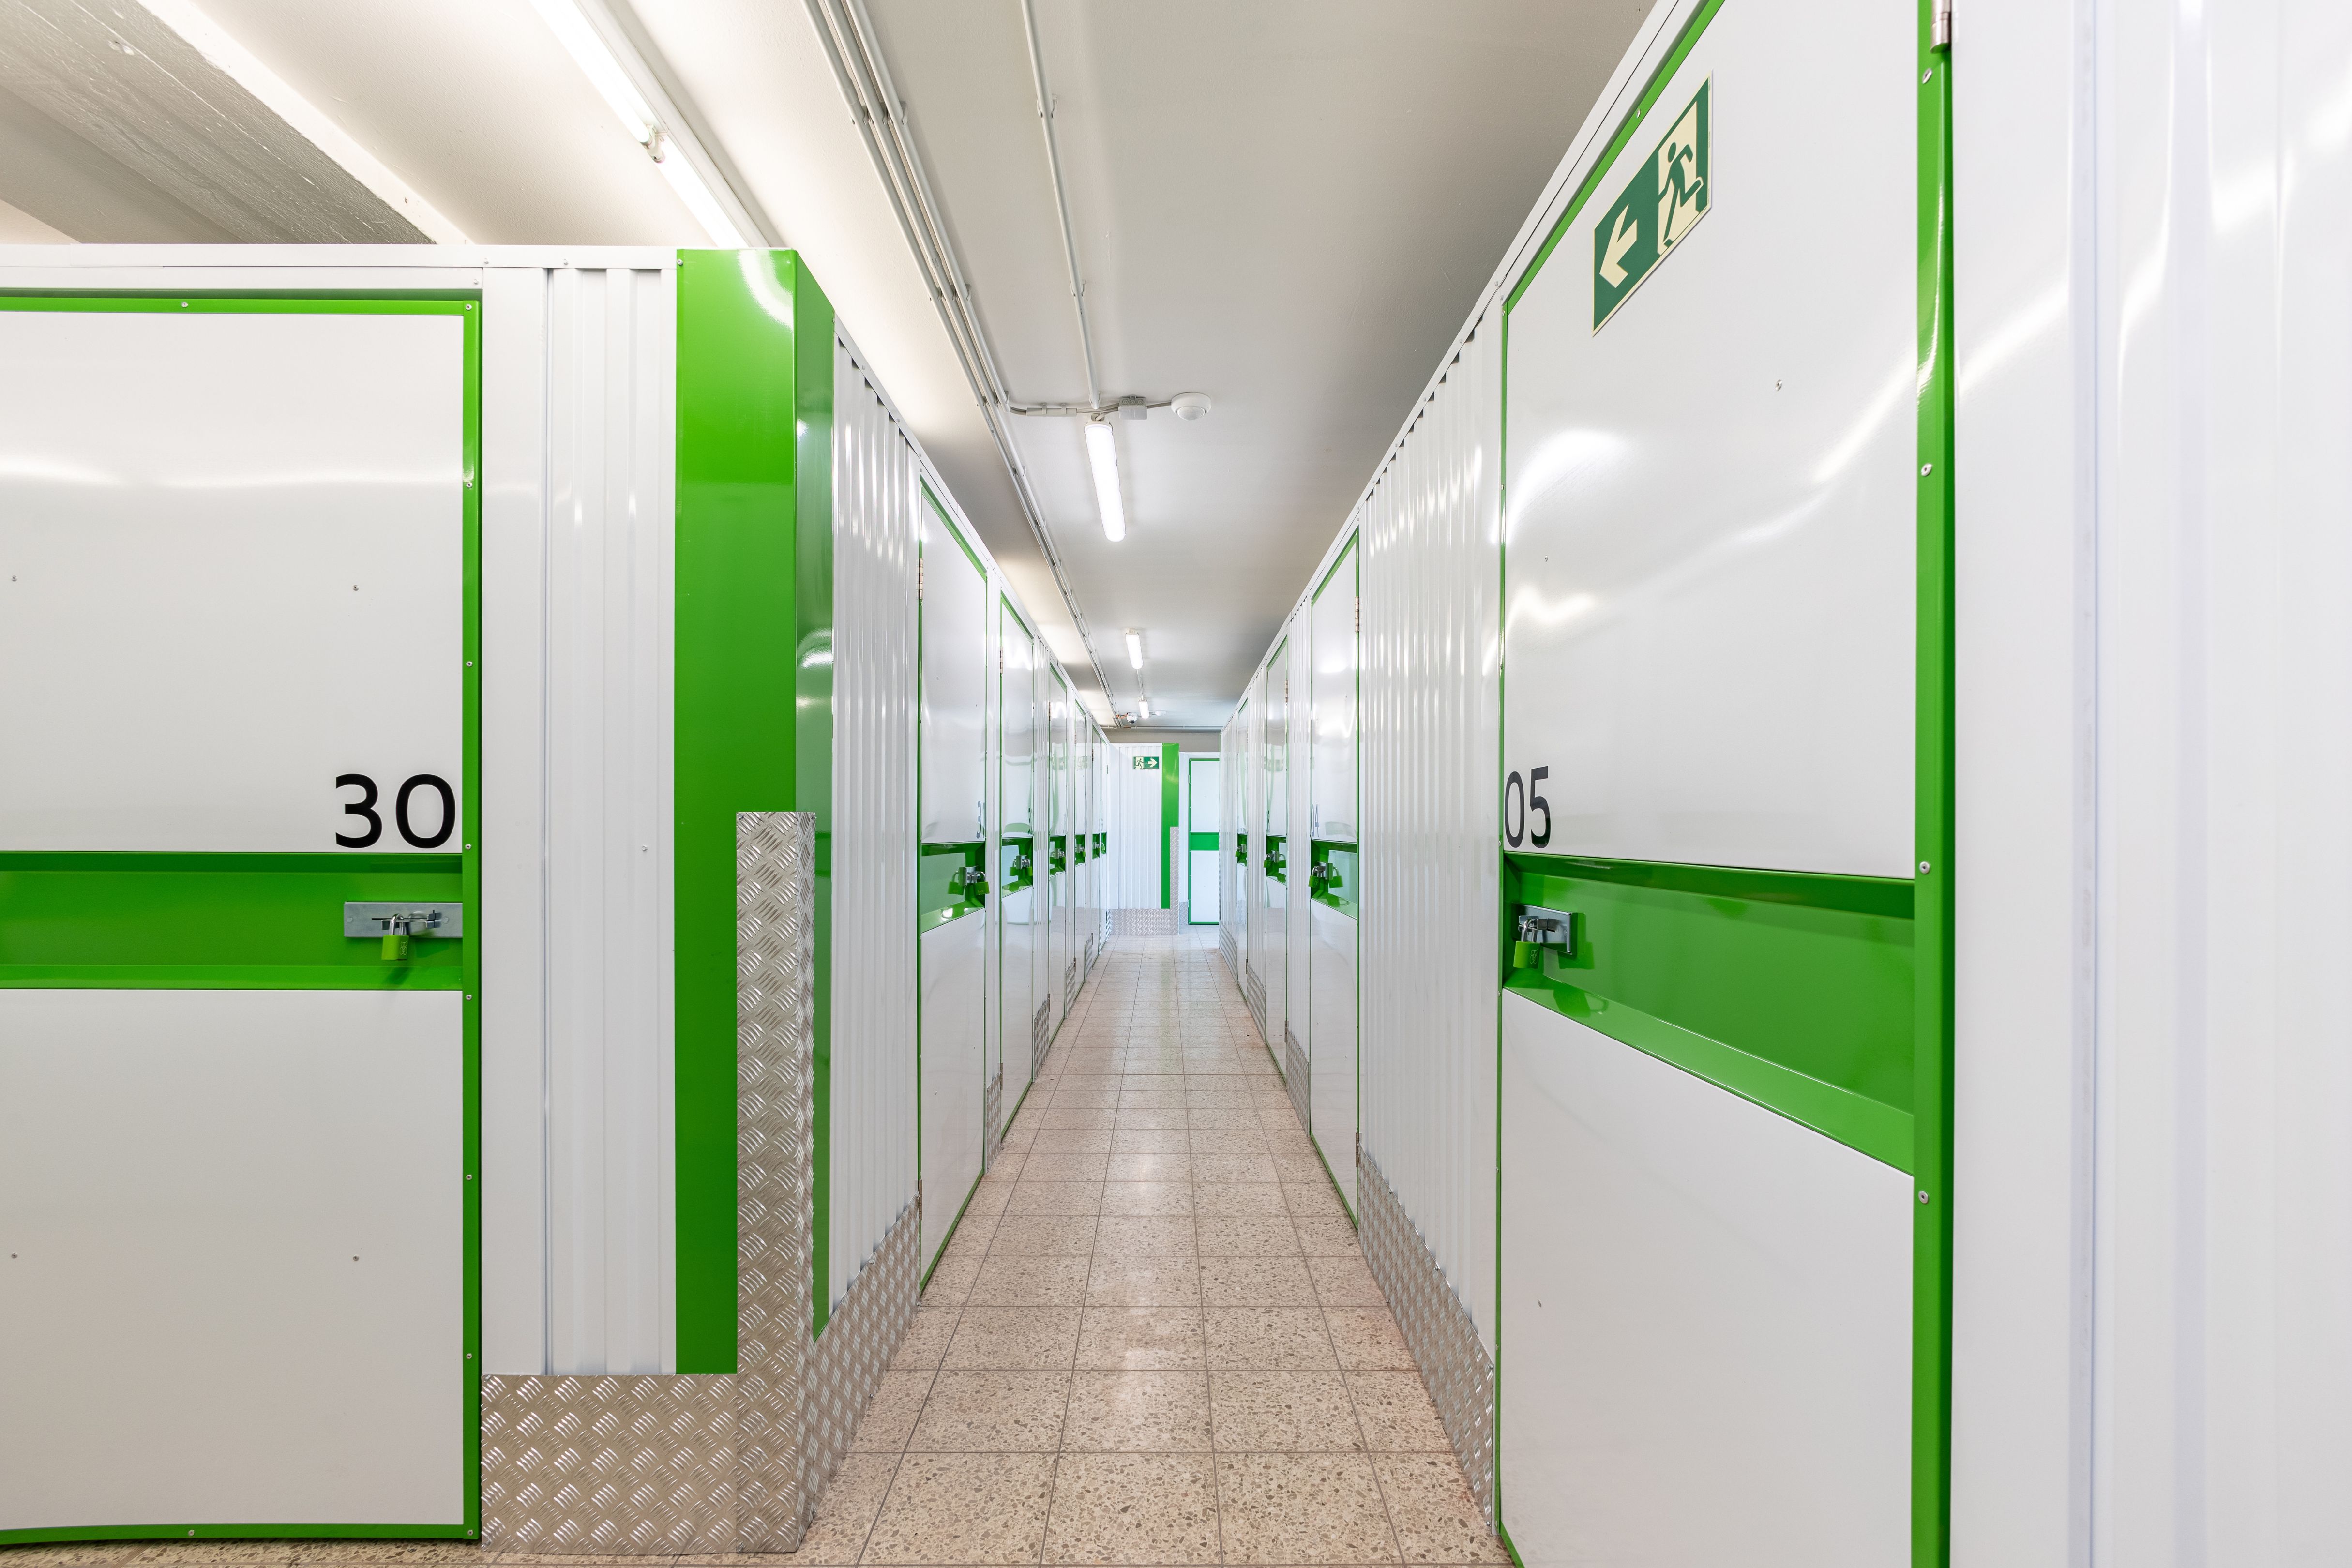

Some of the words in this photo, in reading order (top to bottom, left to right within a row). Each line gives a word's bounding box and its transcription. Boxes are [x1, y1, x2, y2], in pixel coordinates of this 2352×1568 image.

[336, 773, 456, 849] 30
[976, 801, 985, 839] 31
[1311, 804, 1319, 838] 04
[1505, 766, 1551, 849] 05
